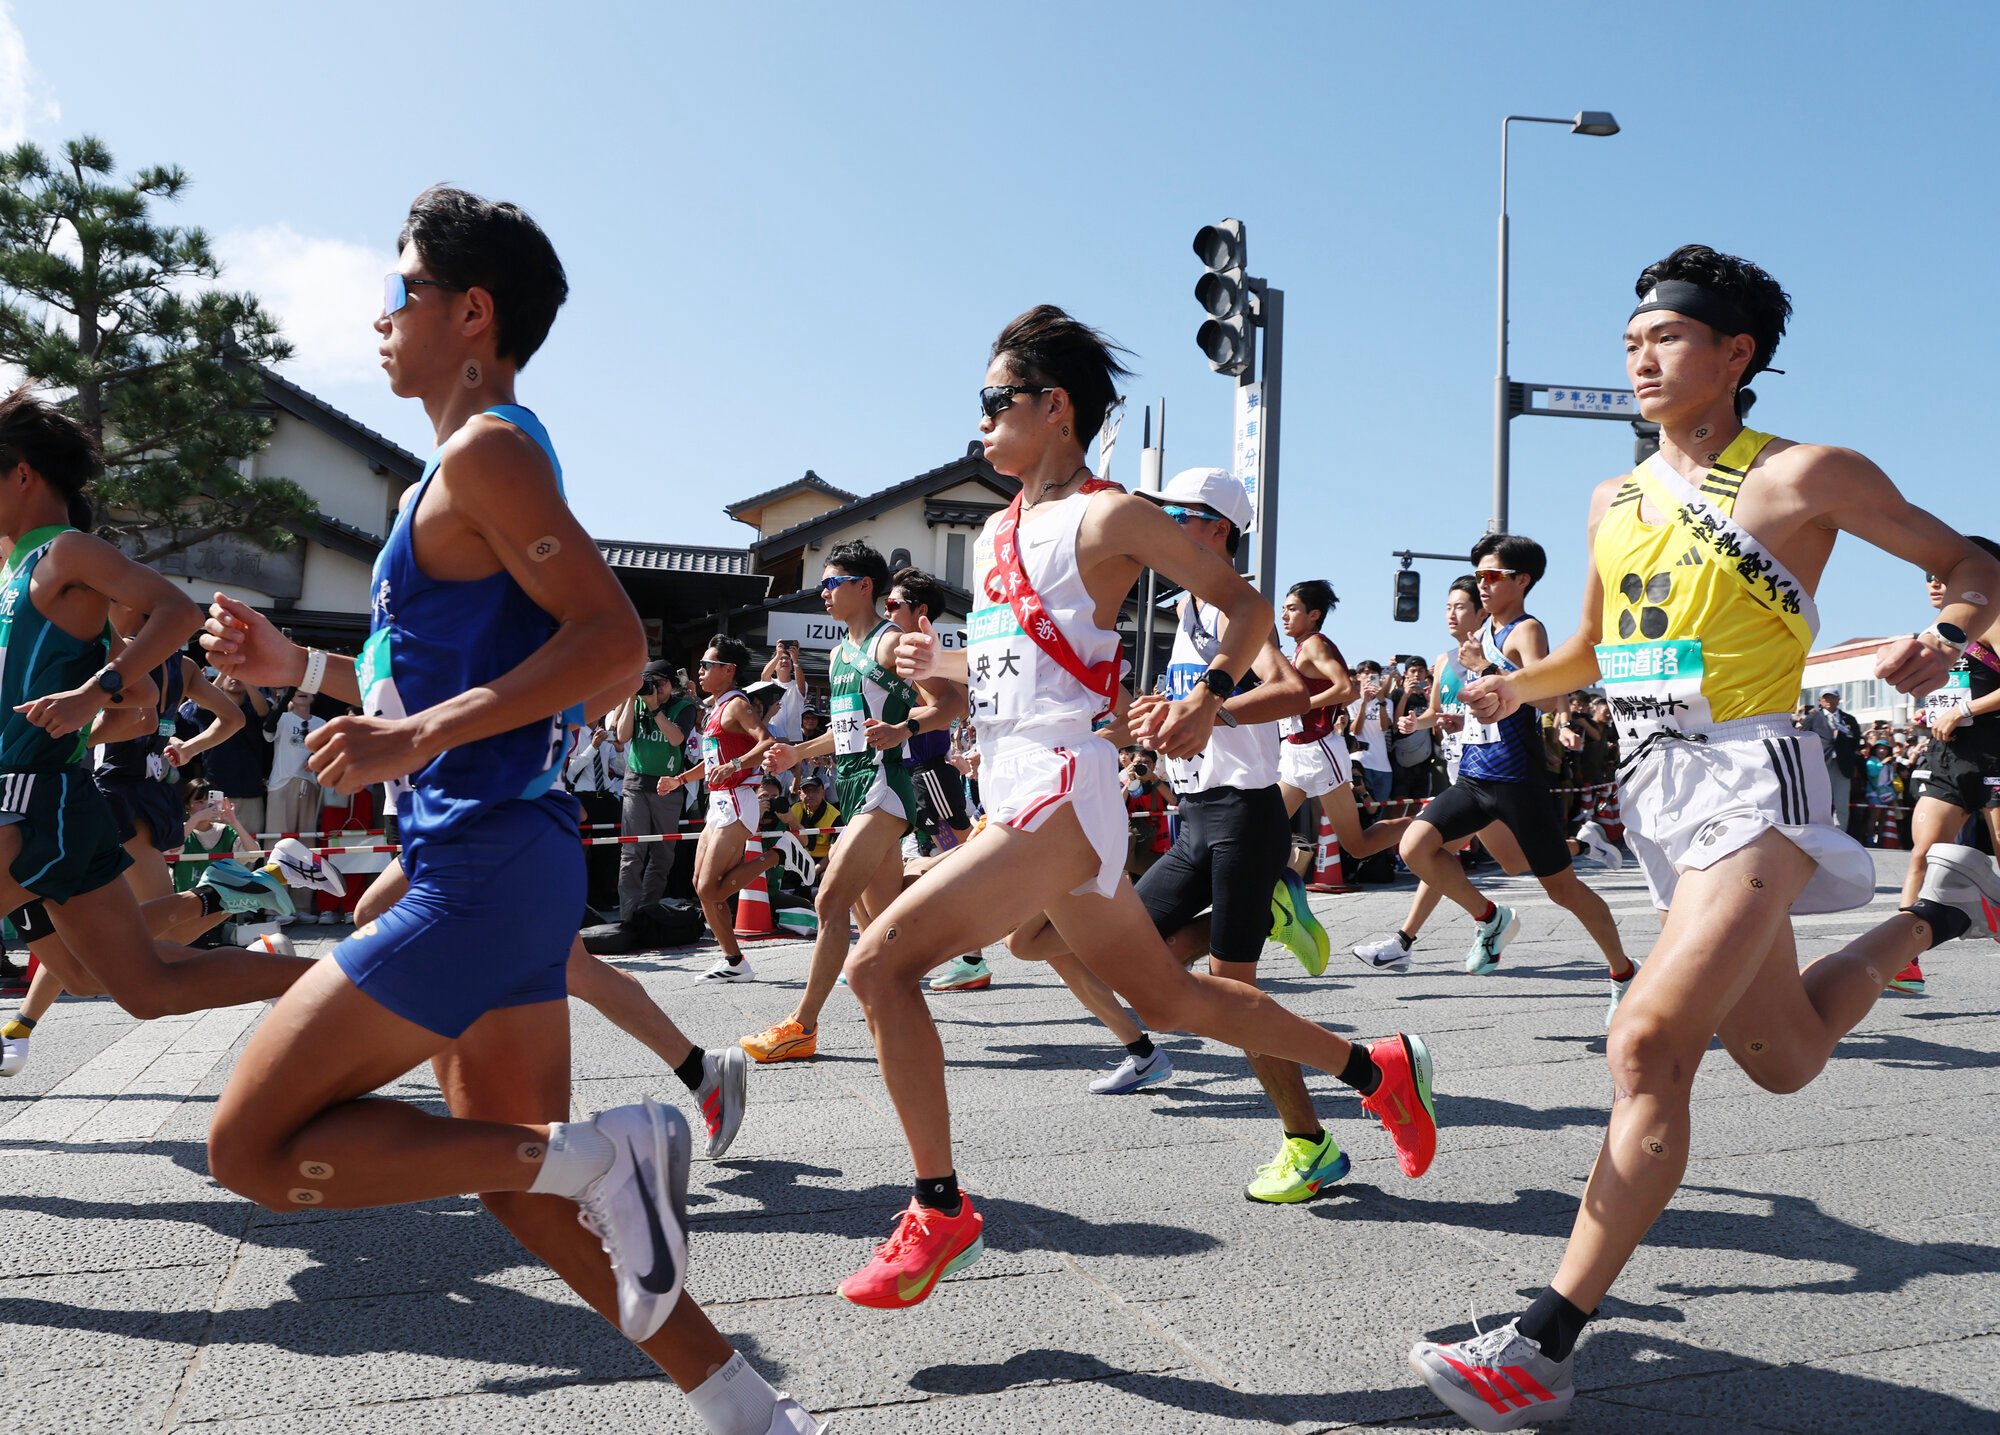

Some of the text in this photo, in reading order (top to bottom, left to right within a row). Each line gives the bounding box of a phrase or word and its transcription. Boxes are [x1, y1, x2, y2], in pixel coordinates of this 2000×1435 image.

[1554, 390, 1628, 405] 歩車分離式
[1243, 392, 1260, 508] 歩車分離
[806, 624, 849, 641] IZUM
[968, 649, 1021, 683] 央大
[667, 755, 675, 772] 4
